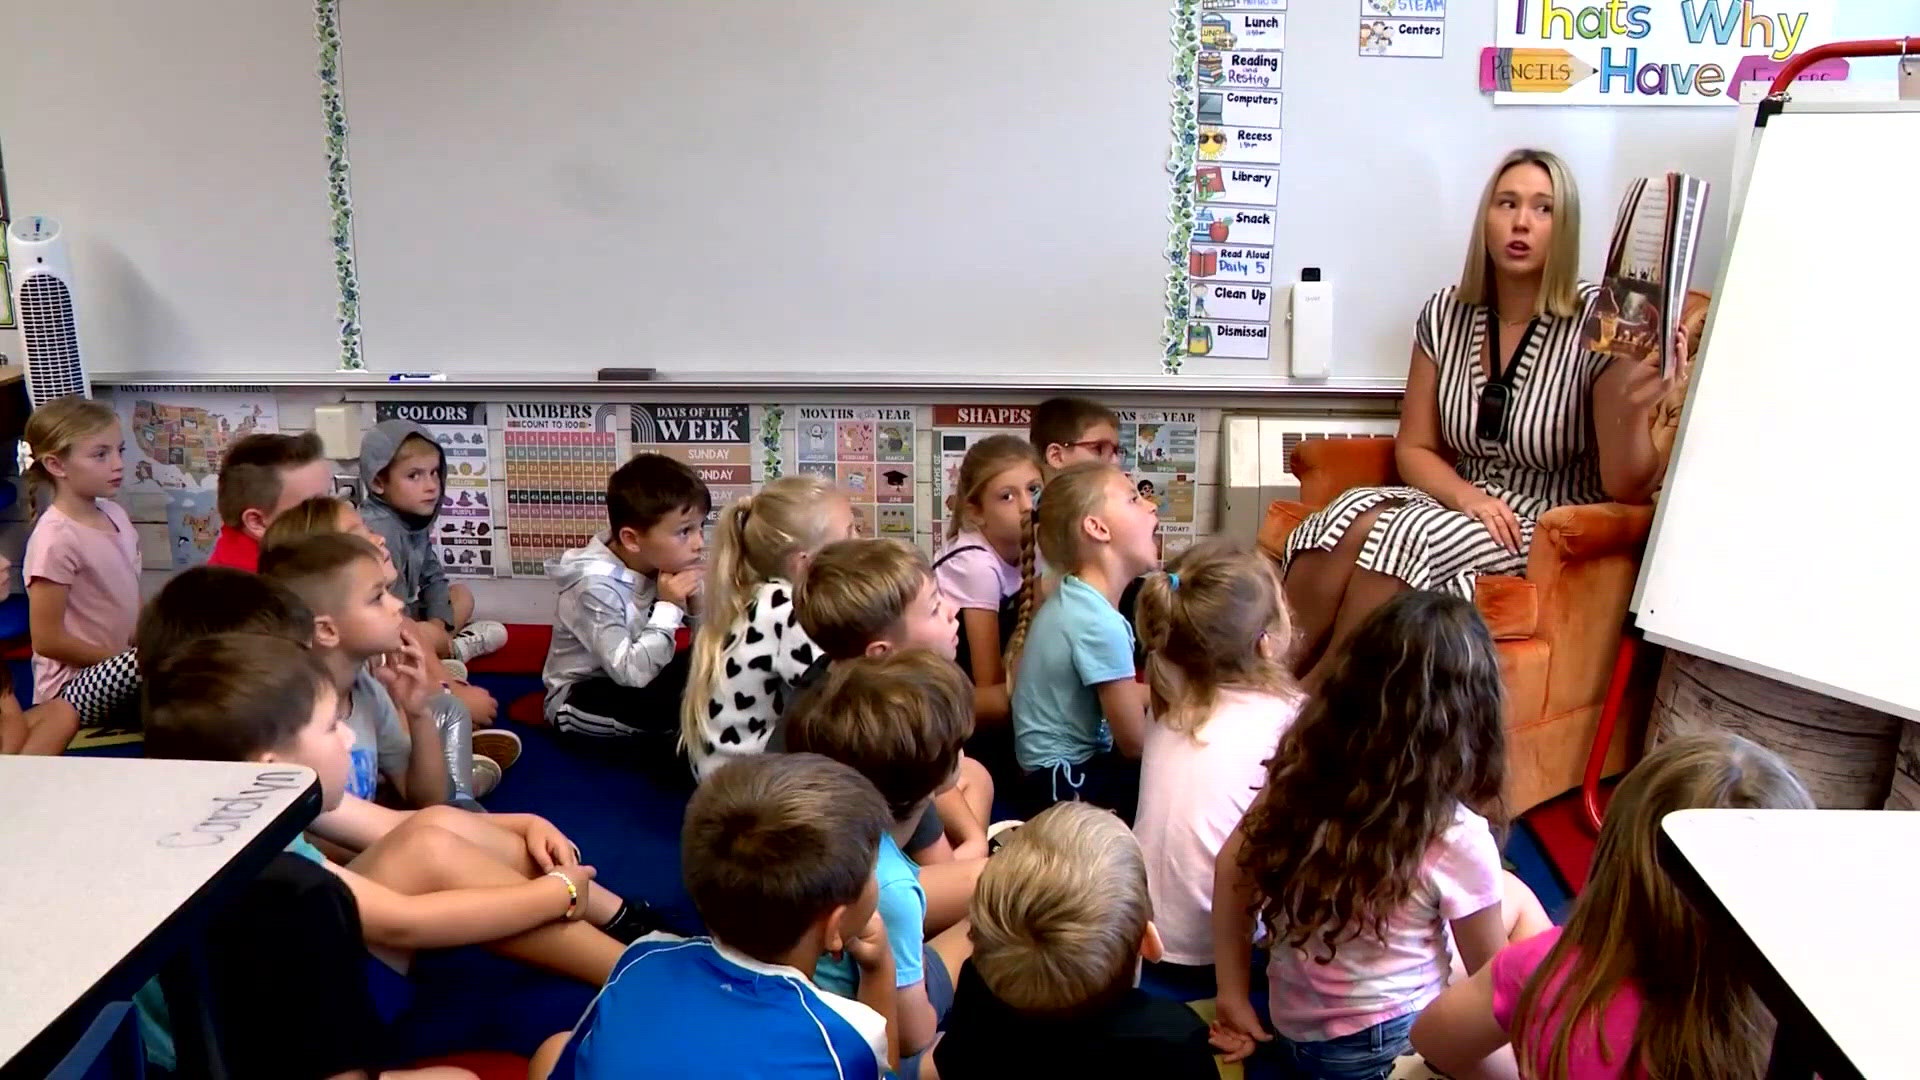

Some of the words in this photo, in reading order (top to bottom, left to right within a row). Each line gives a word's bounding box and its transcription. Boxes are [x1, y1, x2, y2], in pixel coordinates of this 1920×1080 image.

[1245, 15, 1279, 28] Lunch
[1398, 24, 1441, 35] Centers
[1681, 0, 1809, 60] Why
[1232, 54, 1278, 72] Reading
[1491, 55, 1571, 81] PENCILS
[1228, 69, 1270, 87] Resting
[1600, 47, 1725, 97] Have
[1227, 92, 1279, 107] Computers
[1237, 129, 1272, 141] Recess
[1232, 170, 1272, 188] Library
[1236, 211, 1271, 224] Snack
[1220, 248, 1242, 258] Read
[1245, 250, 1270, 259] Aloud
[1219, 260, 1248, 276] Daily
[1255, 261, 1266, 274] 5
[1214, 287, 1247, 299] Clean
[1251, 289, 1267, 305] Up
[1217, 325, 1267, 338] Dismissal
[397, 405, 468, 420] COLORS
[506, 403, 592, 418] NUMBERS
[656, 407, 687, 417] DAYS
[690, 407, 705, 417] OF
[708, 407, 733, 417] THE
[800, 407, 854, 419] MONTHS
[876, 409, 911, 420] YEAR
[957, 407, 1032, 424] SHAPES
[1162, 411, 1196, 422] YEAR
[521, 420, 548, 429] COUNT
[552, 421, 562, 429] TO
[565, 421, 579, 429] 100
[656, 419, 741, 441] WEEK
[688, 449, 730, 460] SUNDAY
[697, 469, 734, 480] ONDAY
